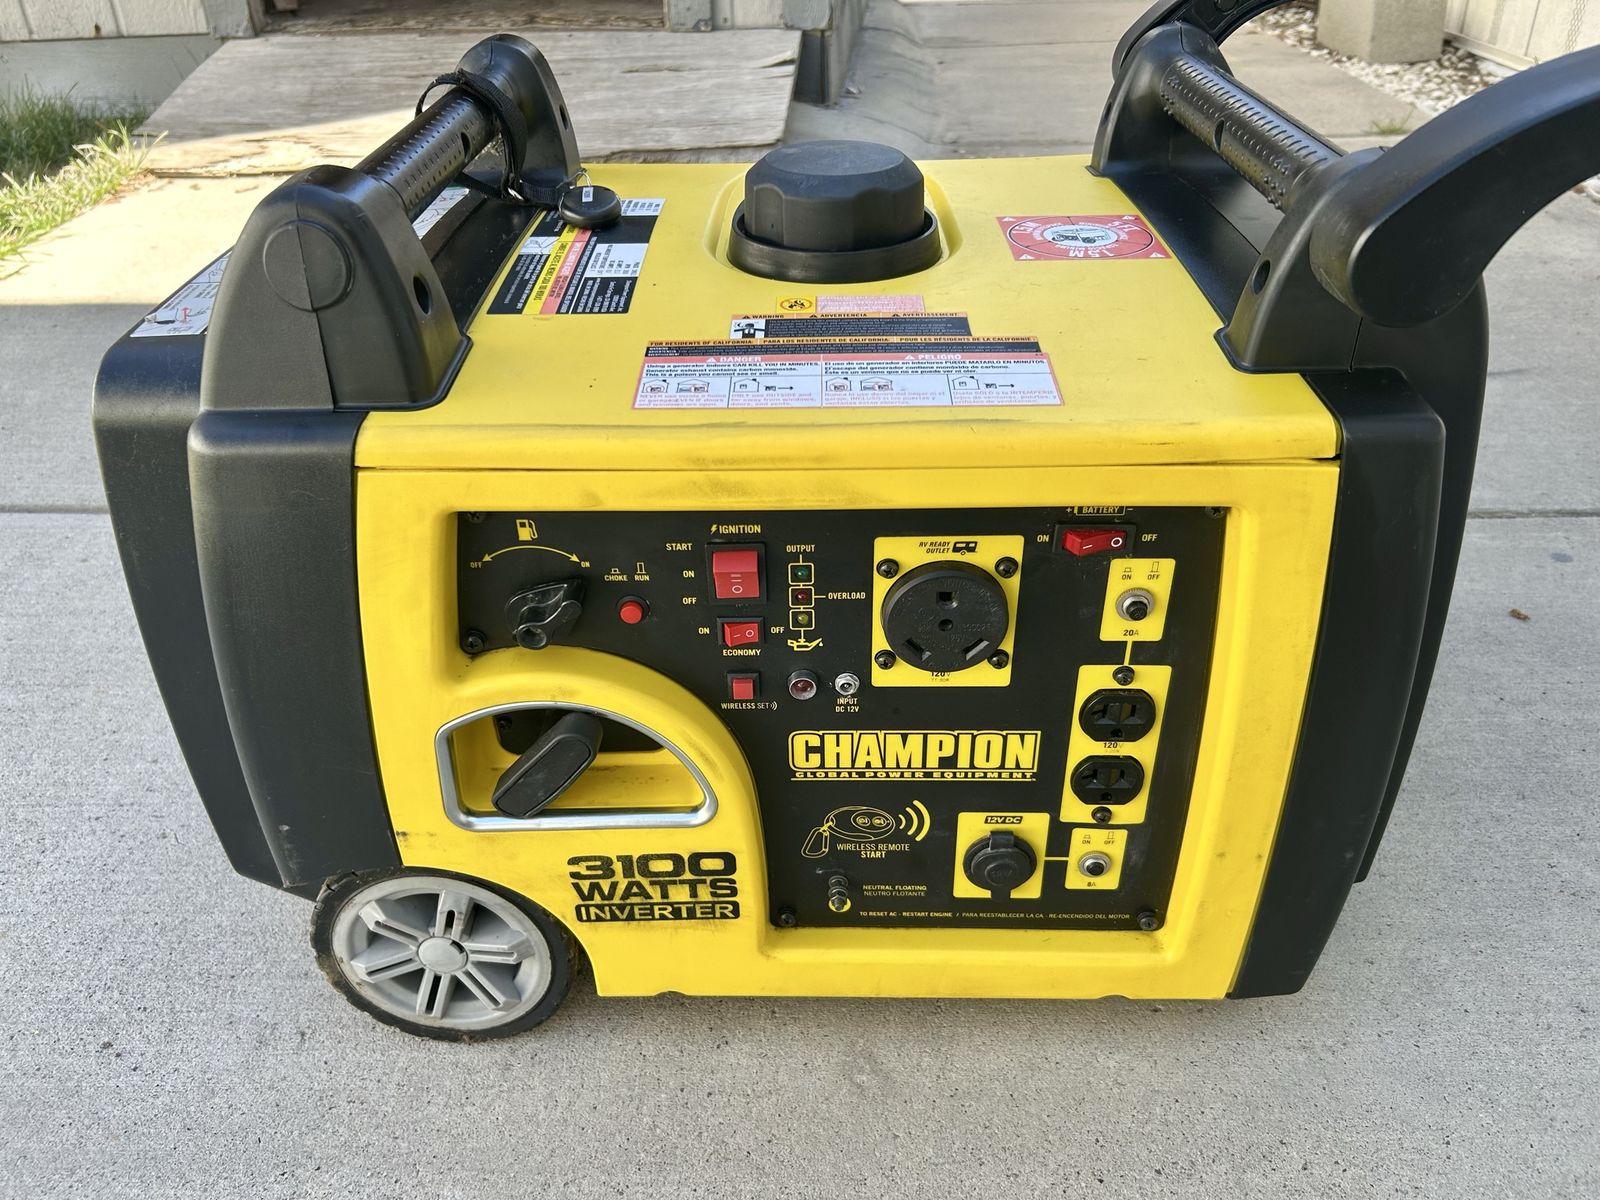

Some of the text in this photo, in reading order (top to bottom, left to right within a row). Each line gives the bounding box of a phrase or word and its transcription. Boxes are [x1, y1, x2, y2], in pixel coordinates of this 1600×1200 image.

[1082, 506, 1120, 514] BATTERY
[719, 524, 761, 534] IGNITION
[791, 731, 1038, 770] CHAMPION
[567, 852, 737, 880] 3100
[571, 878, 738, 902] WATTS
[580, 904, 736, 920] INVERTER
